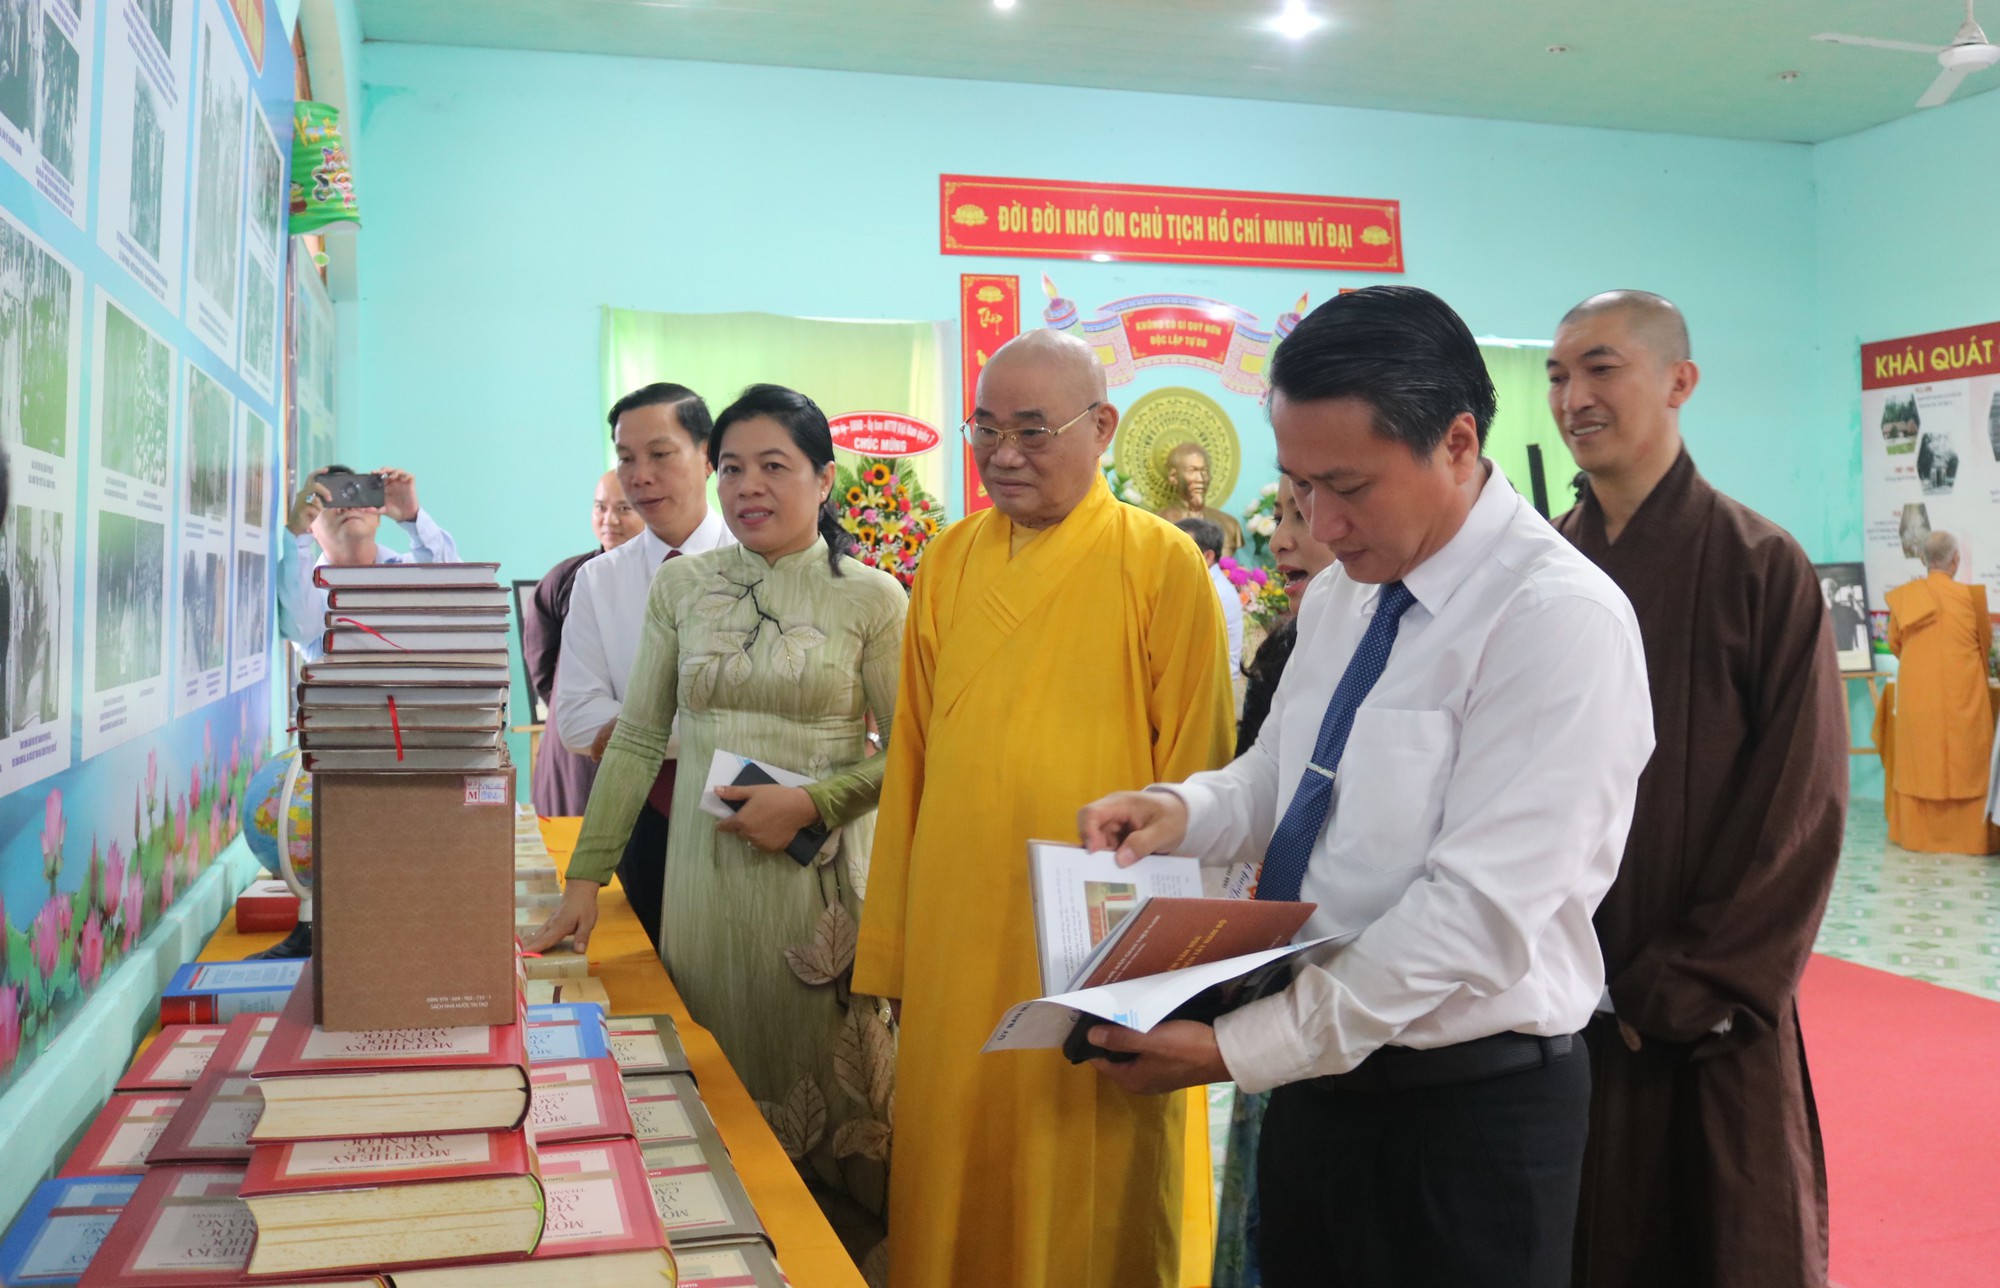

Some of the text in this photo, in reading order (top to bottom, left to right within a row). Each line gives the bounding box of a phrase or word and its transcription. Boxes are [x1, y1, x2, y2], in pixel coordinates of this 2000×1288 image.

[998, 200, 1353, 254] ĐỜI ĐỜI NHỚ ƠN CHỦ TỊCH HỒ CHÍ MINH VĨ ĐẠI
[1930, 335, 1994, 371] QUÁT
[854, 435, 907, 452] CHÚC MỪNG
